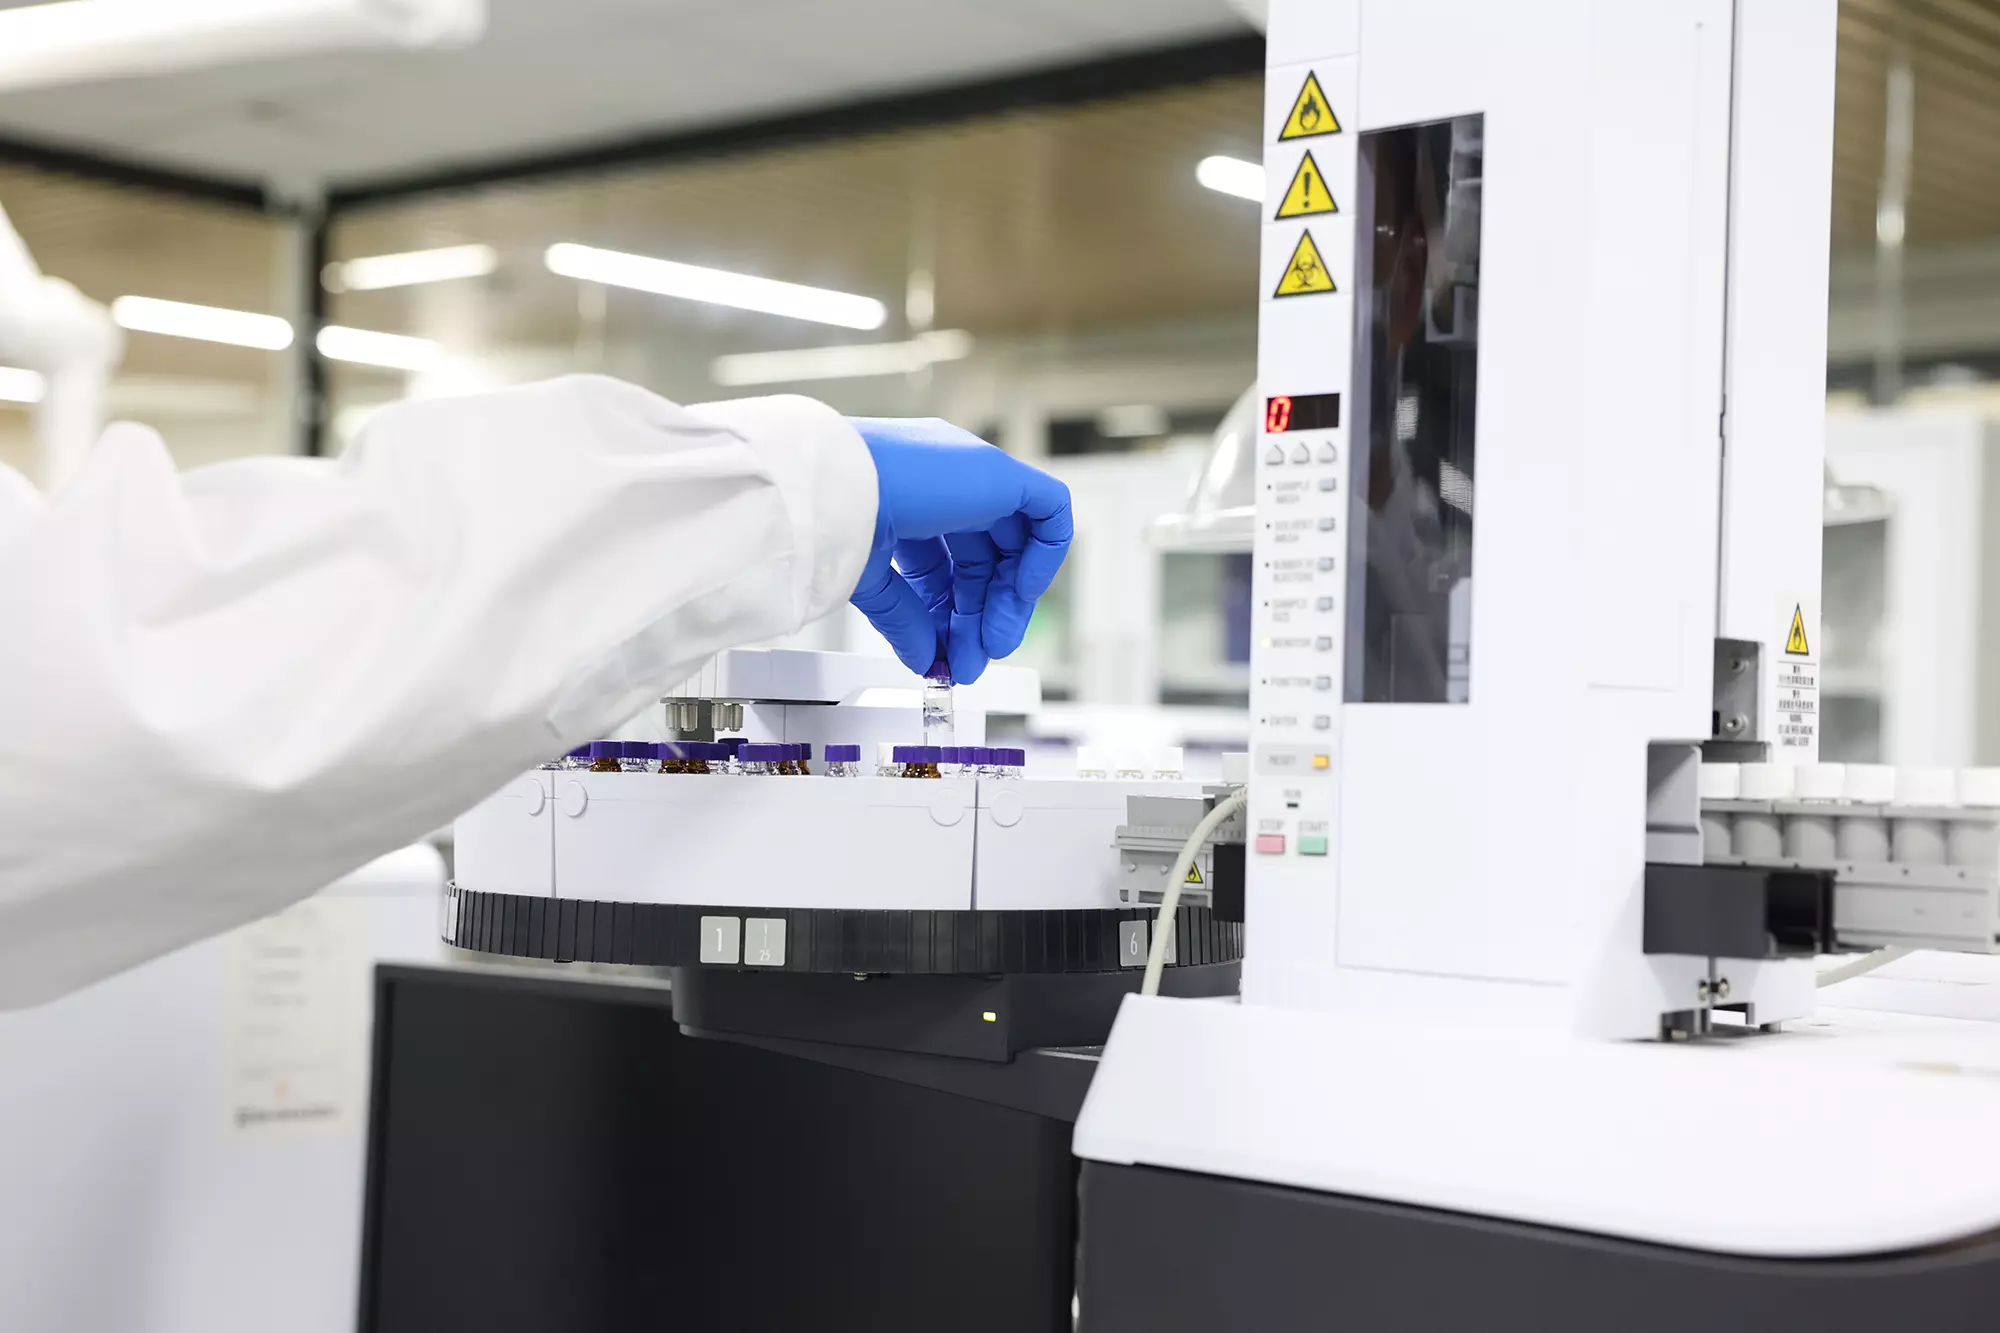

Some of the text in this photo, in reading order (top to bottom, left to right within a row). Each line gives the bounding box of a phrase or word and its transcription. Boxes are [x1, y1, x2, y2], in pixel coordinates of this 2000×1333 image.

[1265, 395, 1292, 433] 0
[1259, 818, 1329, 833] STOP START
[716, 927, 723, 953] 1
[1130, 932, 1138, 956] 6
[759, 949, 771, 961] 25
